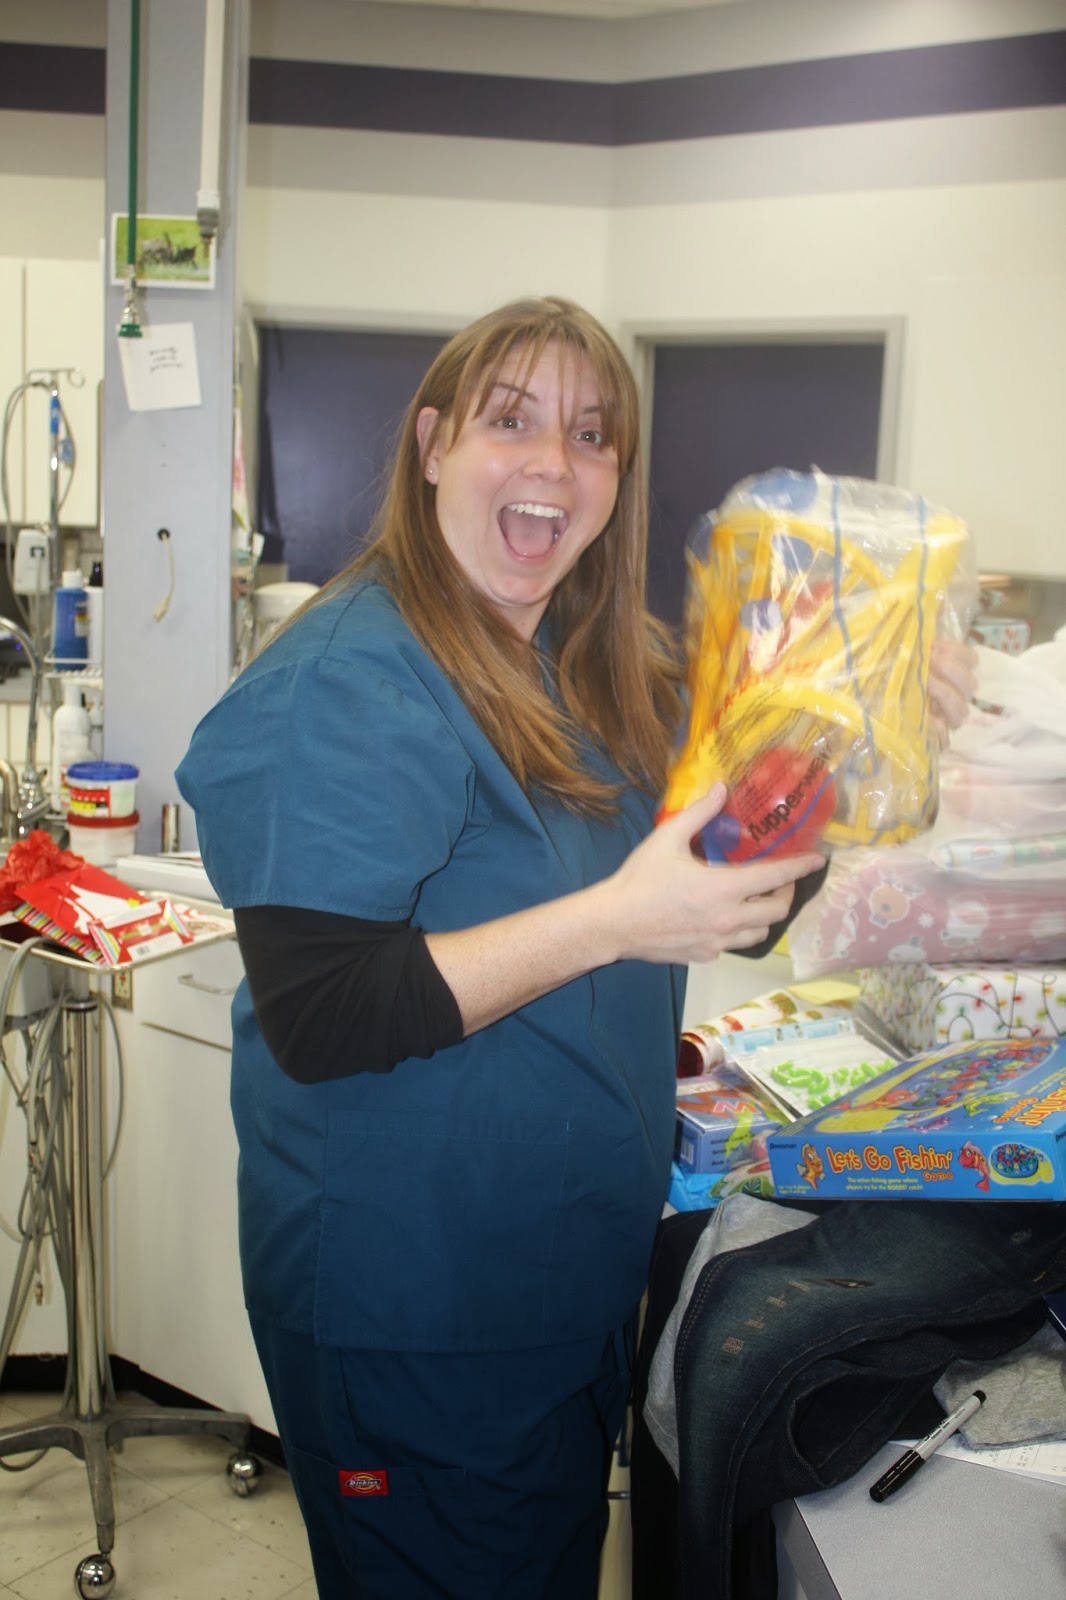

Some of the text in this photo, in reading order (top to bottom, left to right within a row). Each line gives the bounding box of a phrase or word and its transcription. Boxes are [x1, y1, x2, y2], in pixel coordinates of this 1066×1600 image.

[826, 1144, 953, 1173] Let's Go Fishin'
[922, 1171, 954, 1182] Game
